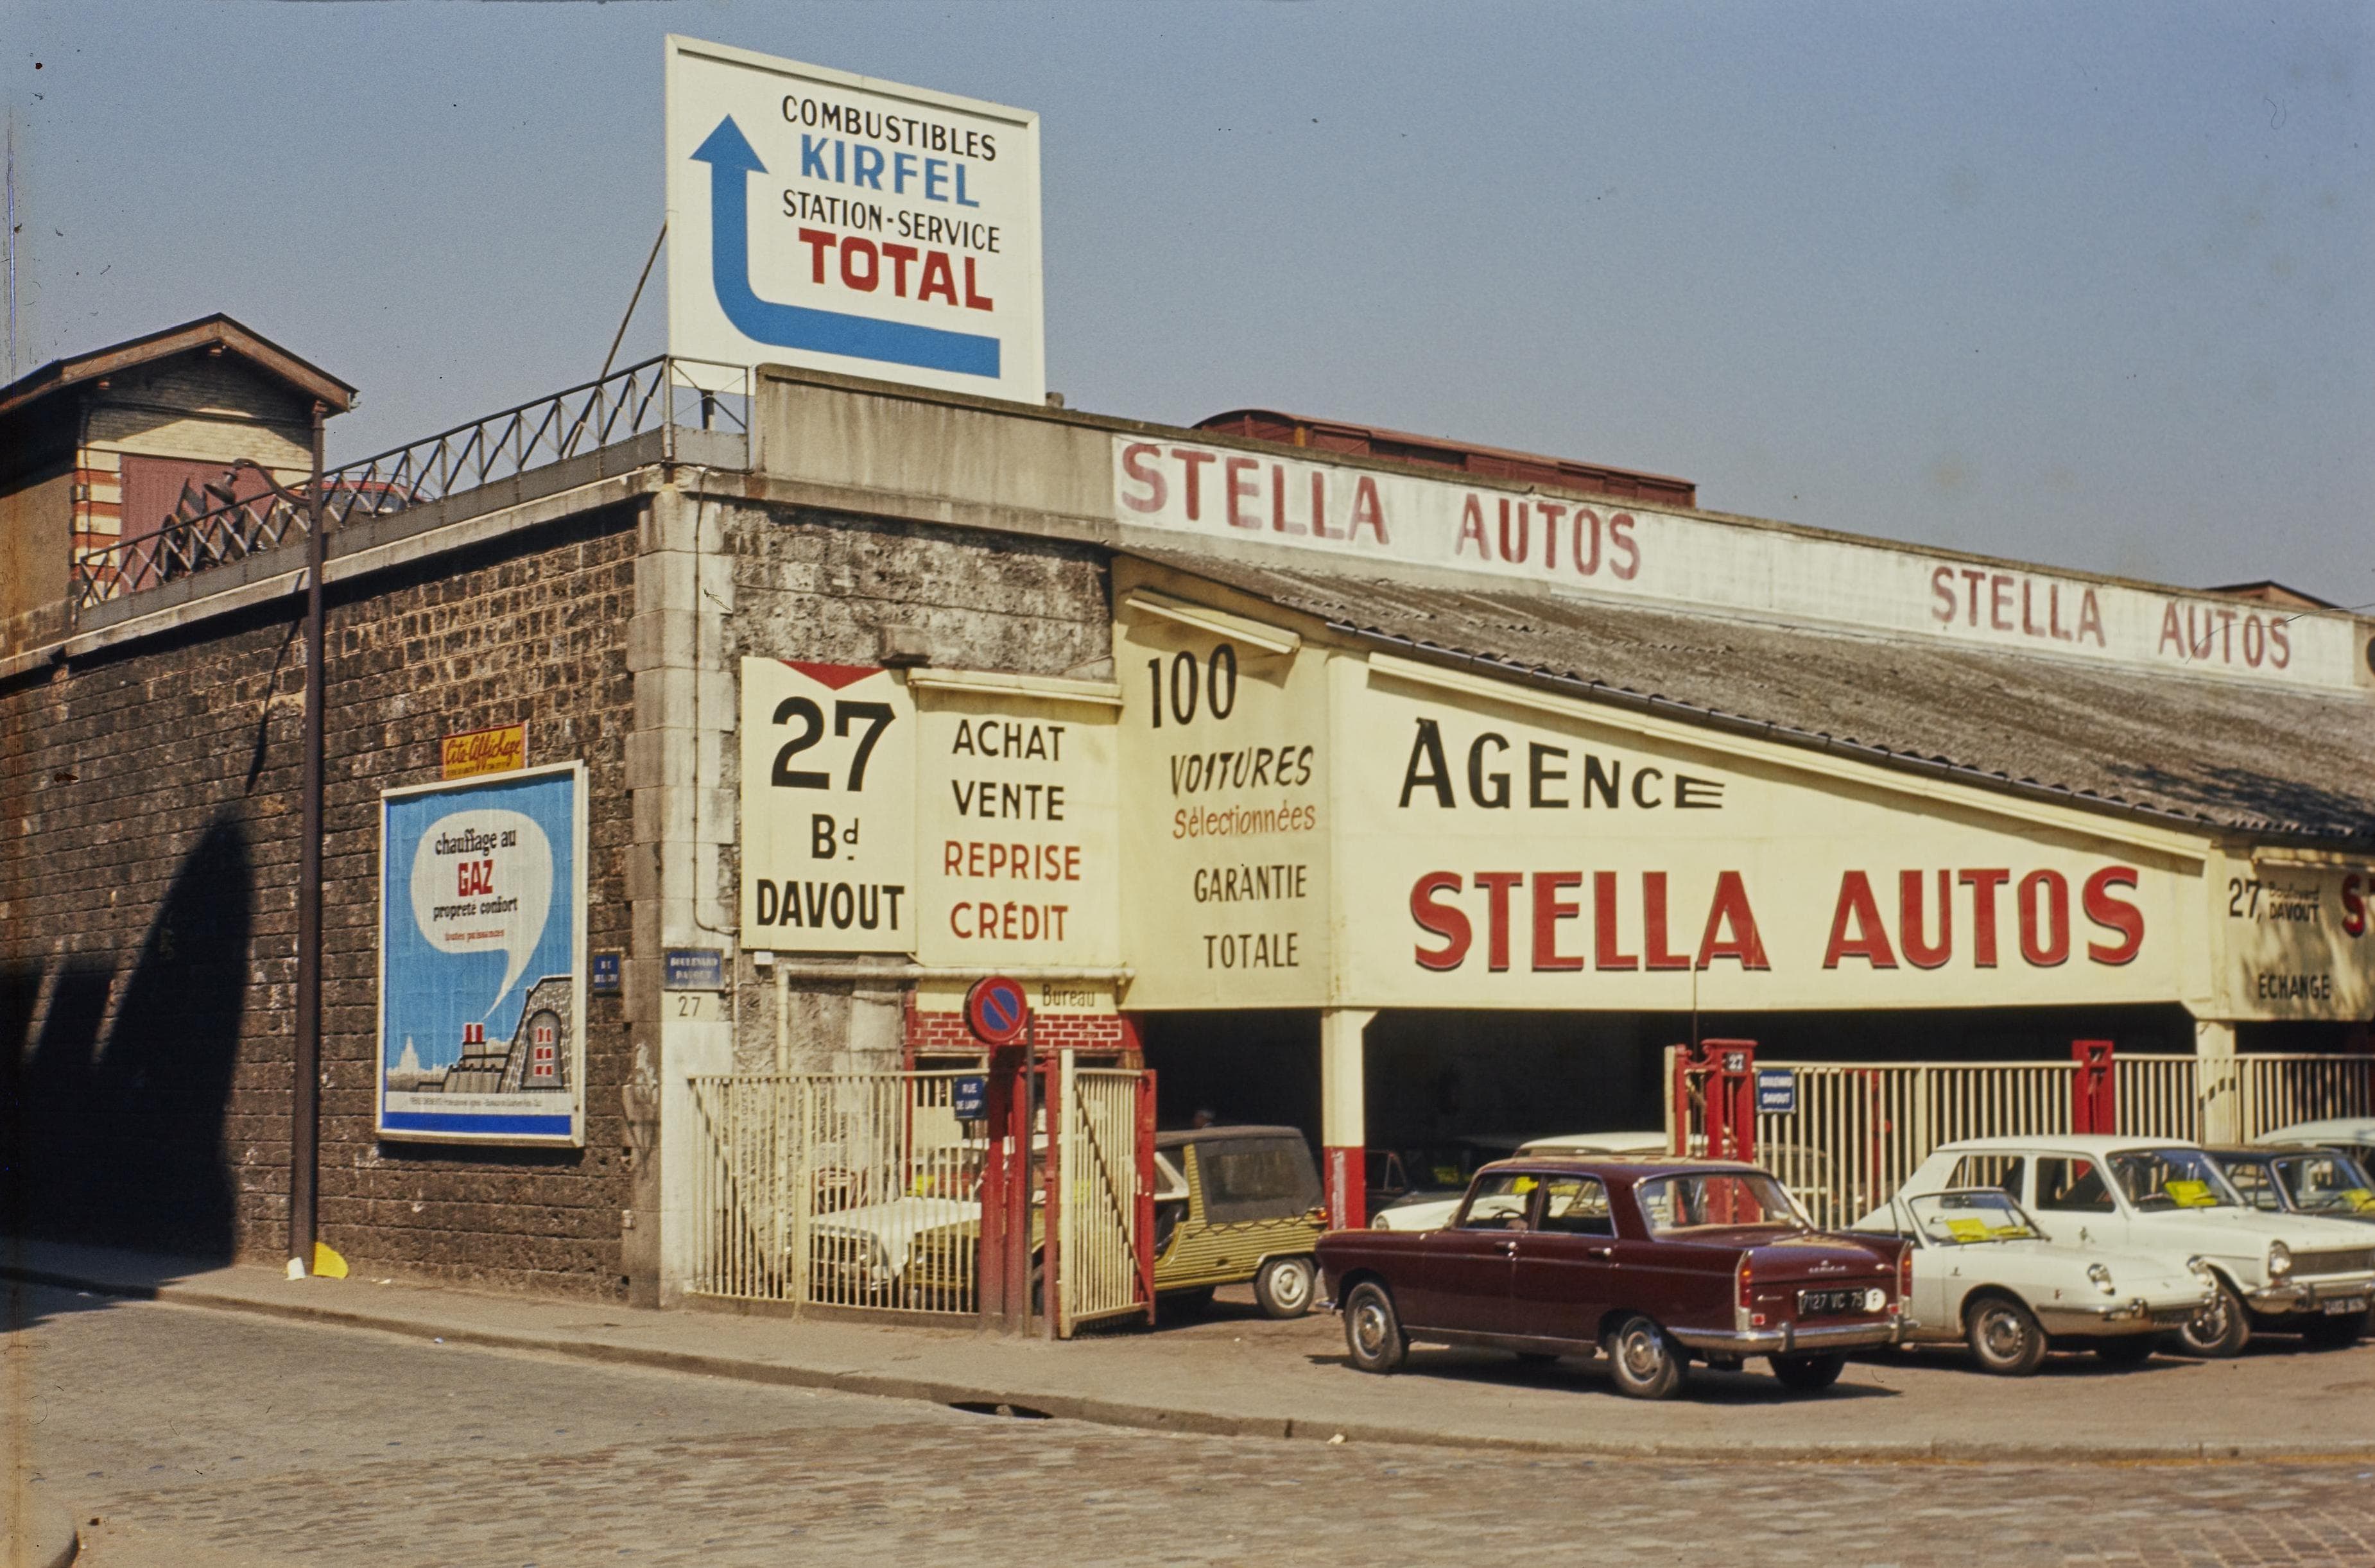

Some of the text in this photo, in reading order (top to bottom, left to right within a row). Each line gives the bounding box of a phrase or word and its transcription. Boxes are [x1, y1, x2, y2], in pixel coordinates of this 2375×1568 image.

[782, 94, 996, 162] COMBUSTIBLES
[801, 134, 980, 208] KIRFEL
[782, 189, 1000, 254] STATION-SERVICE
[798, 227, 994, 312] TOTAL
[1121, 442, 1641, 580] STELLA AUTOS
[1931, 565, 2292, 669] STELLA AUTOS
[1148, 643, 1238, 728] 100
[771, 696, 897, 792] 27
[951, 718, 1065, 762] ACHAT
[1171, 745, 1314, 797] VOITURES
[1398, 716, 1725, 809] AGENCE
[951, 779, 1066, 821] VENTE
[1172, 800, 1317, 840] Sélectionnées
[435, 827, 517, 856] chauffage au
[944, 840, 1082, 882] REPRISE
[458, 859, 494, 897] GAZ
[1194, 865, 1308, 903] GARANTIE
[433, 895, 518, 922] propreté confort
[756, 879, 905, 931] DAVOUT
[950, 900, 1069, 942] CRÉDIT
[1410, 865, 2145, 974] STELLA AUTOS
[2269, 902, 2320, 922] DAVOUT
[1204, 932, 1299, 969] TOTALE
[678, 995, 702, 1017] 27
[1042, 984, 1095, 1008] Bureau
[2258, 973, 2331, 999] ECHANGE
[1728, 1053, 1745, 1071] 27
